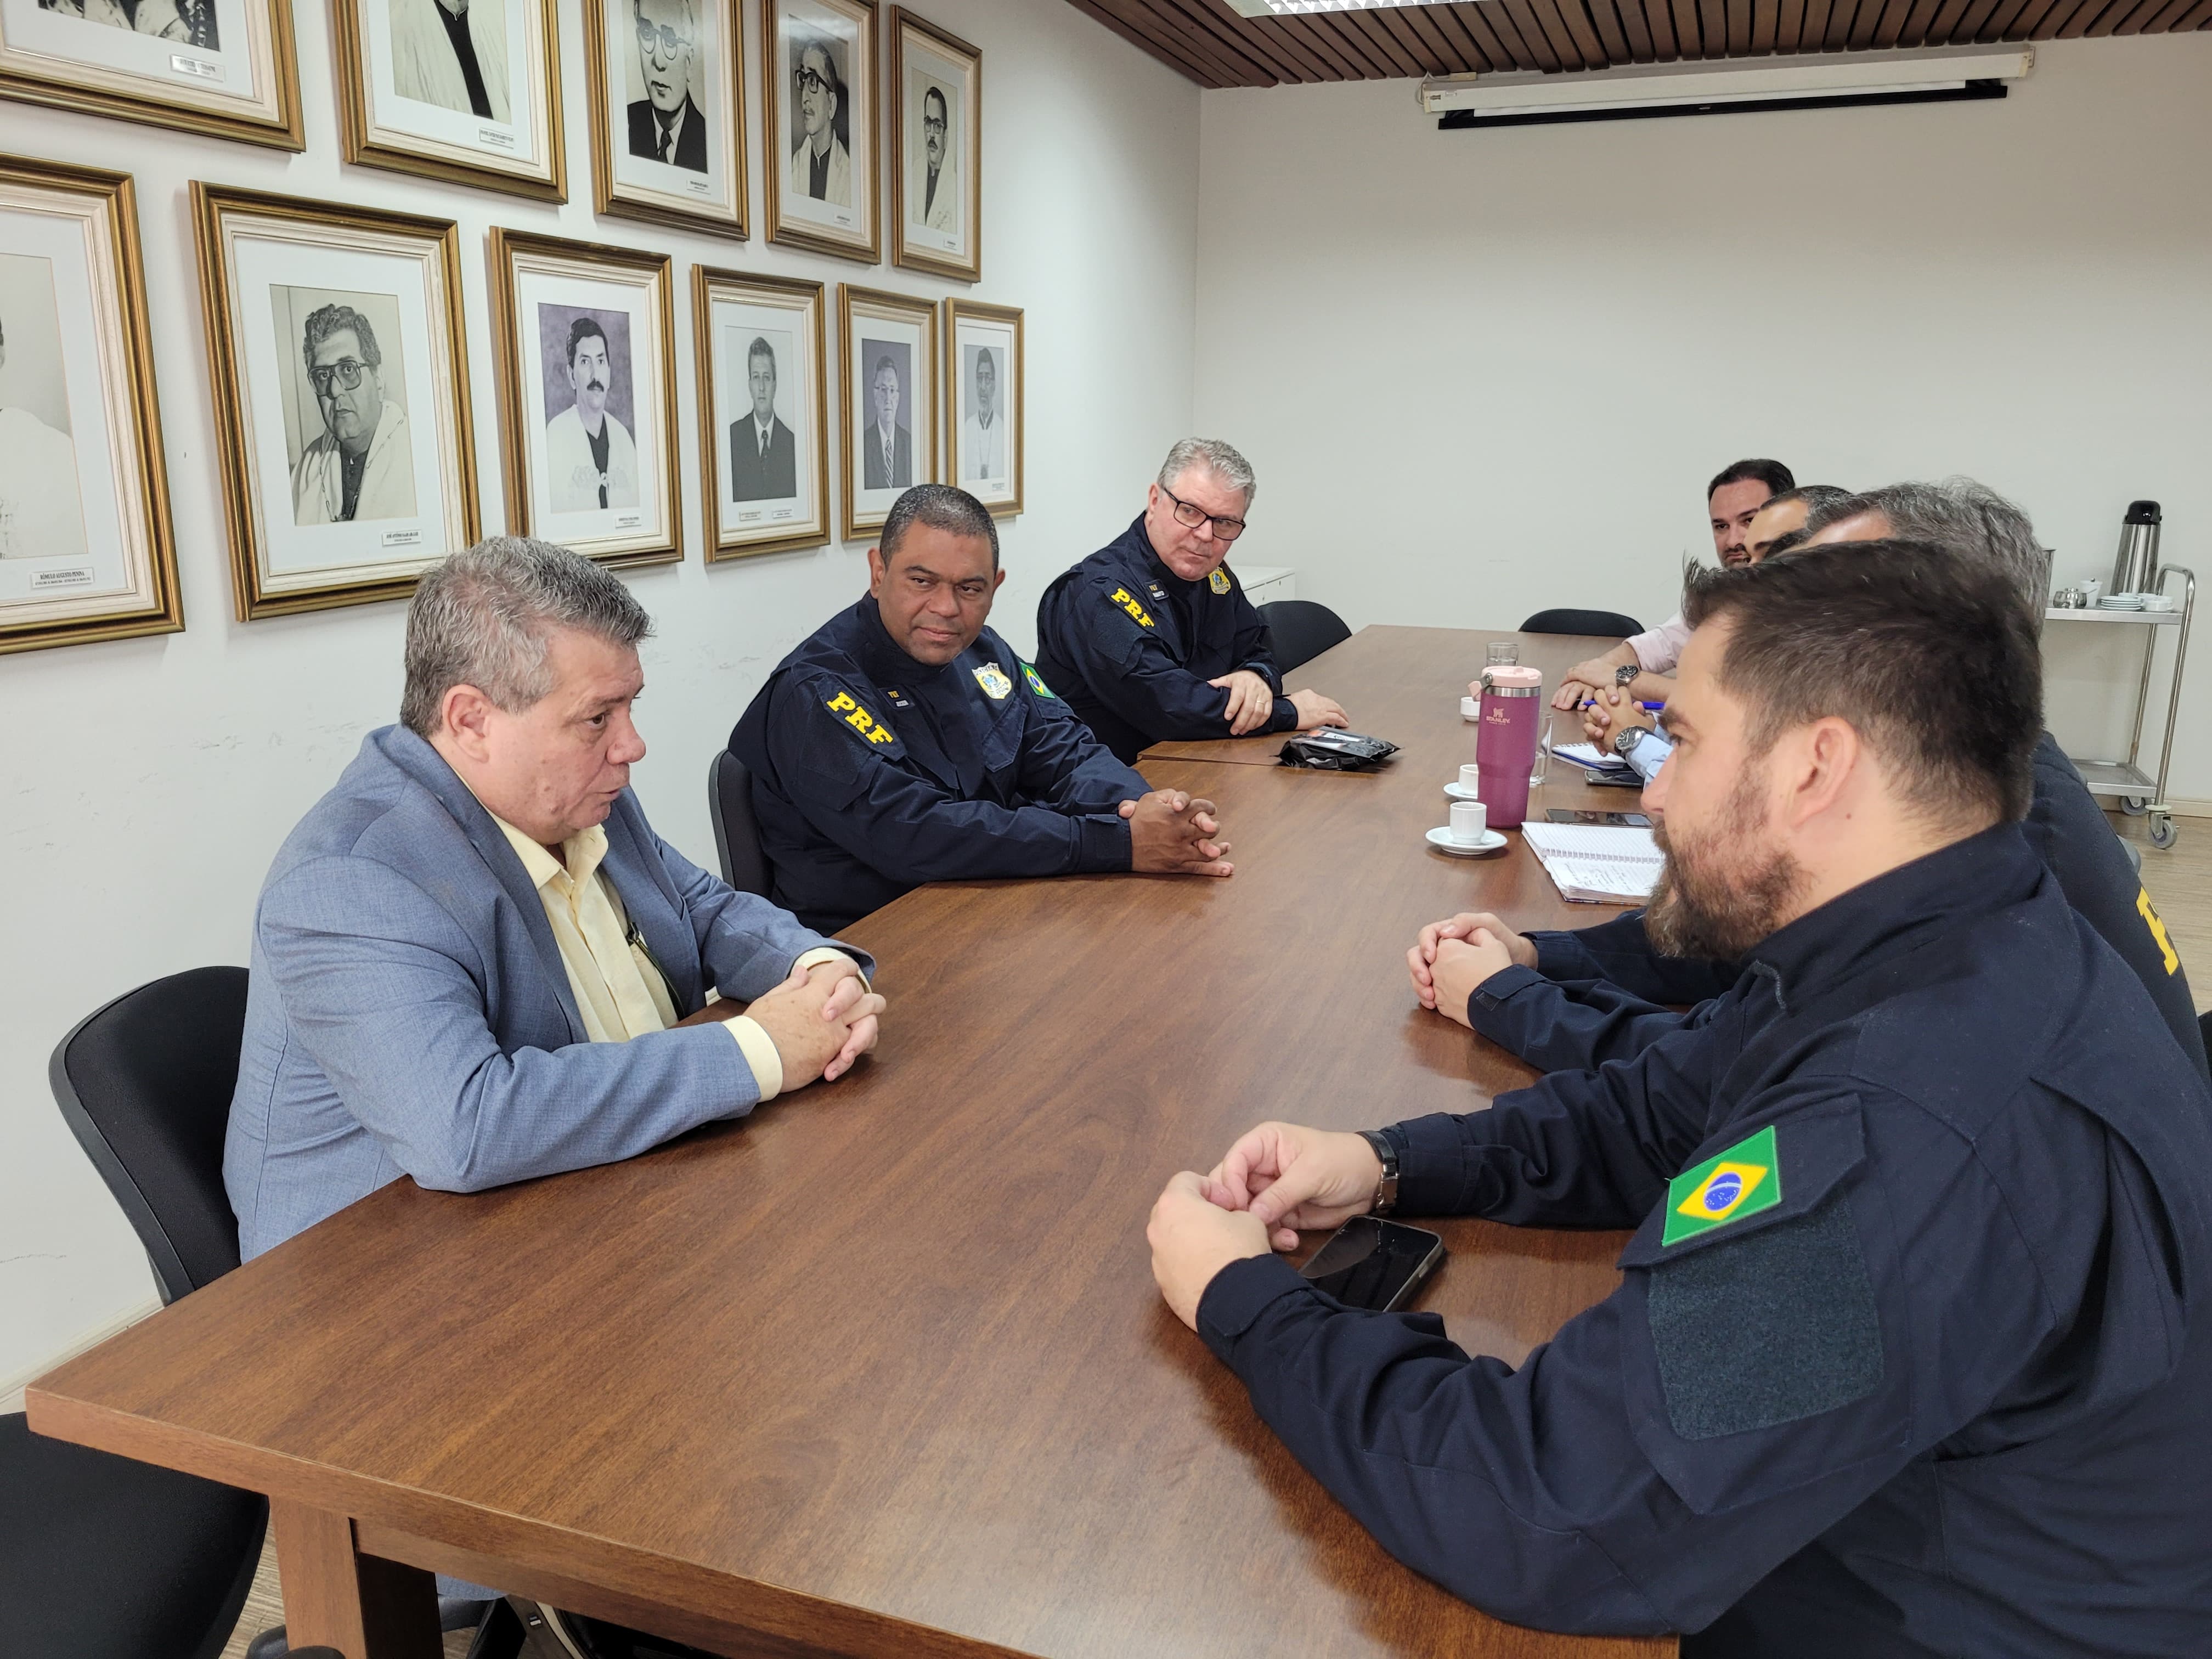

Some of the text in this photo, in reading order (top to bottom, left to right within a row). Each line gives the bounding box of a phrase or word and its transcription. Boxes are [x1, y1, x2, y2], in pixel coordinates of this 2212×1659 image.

[1110, 588, 1155, 627] PRF
[826, 691, 894, 744] PRF
[1486, 715, 1510, 724] STANLEY
